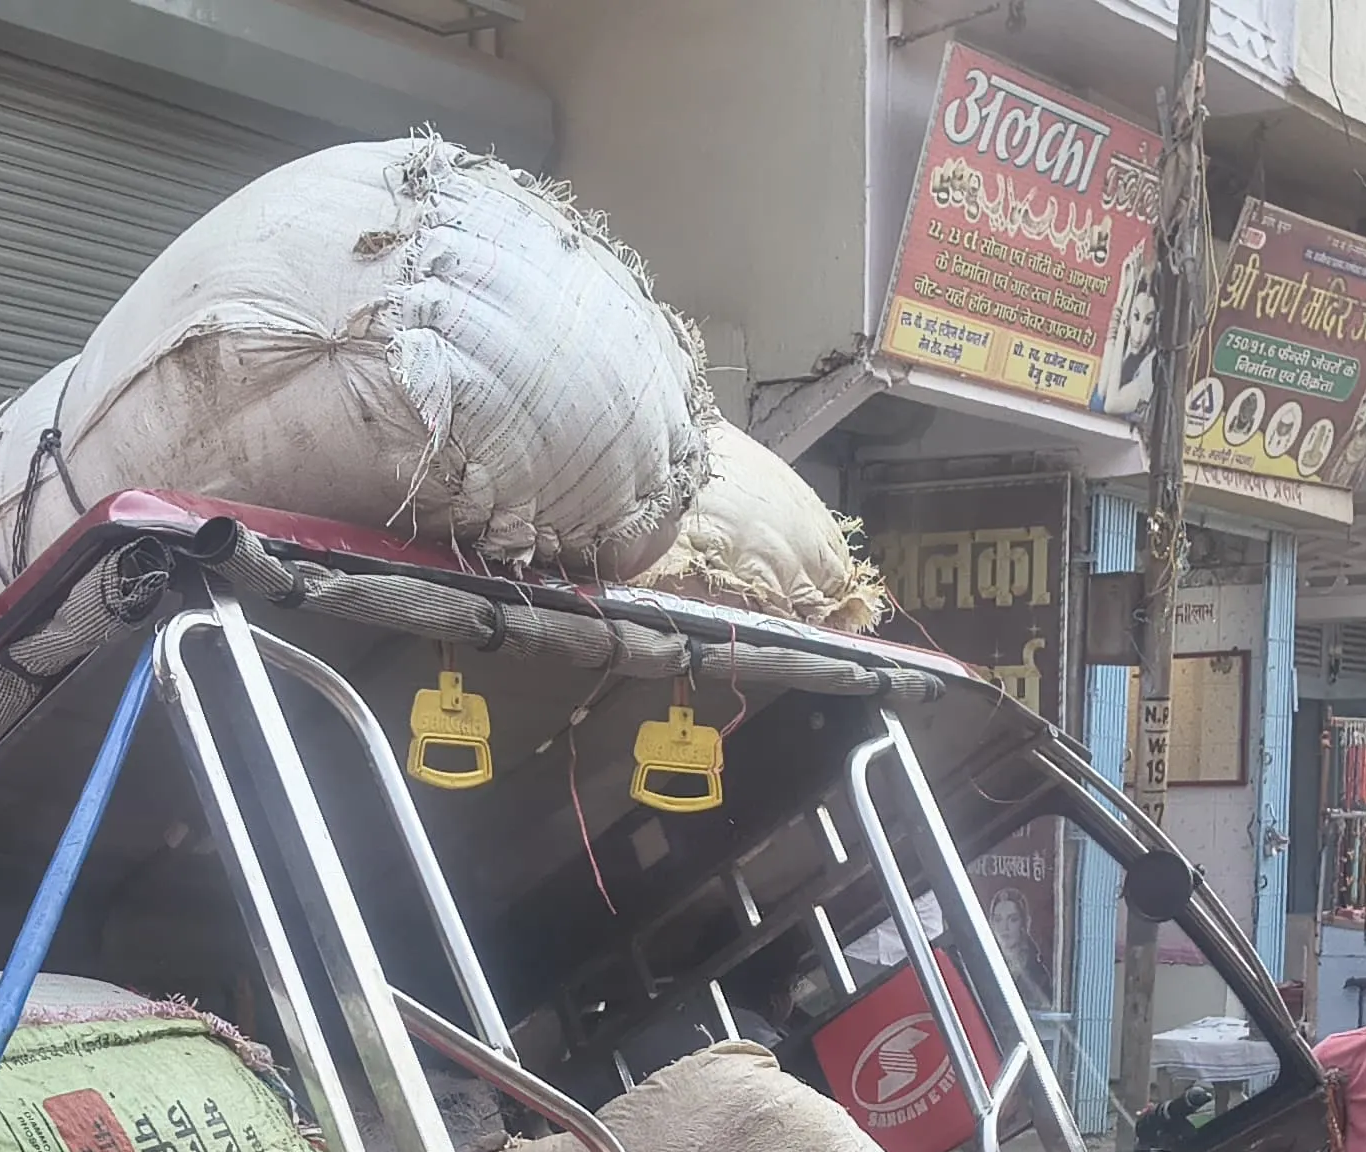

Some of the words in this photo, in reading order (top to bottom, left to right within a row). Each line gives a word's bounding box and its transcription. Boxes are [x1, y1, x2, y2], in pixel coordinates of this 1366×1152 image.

[943, 66, 1111, 194] अलका
[935, 251, 949, 272] के
[993, 271, 1013, 290] एवं
[981, 235, 1008, 262] सोना
[1009, 247, 1028, 267] एवं
[1053, 260, 1066, 279] के
[1220, 253, 1260, 310] श्री
[1256, 271, 1311, 325] स्वर्ण
[1301, 277, 1358, 340] मंदिर
[1019, 309, 1044, 330] जेवर
[1234, 355, 1276, 381] निर्माता
[1343, 362, 1359, 378] के
[871, 526, 1052, 613] अलका
[1146, 759, 1165, 784] 19
